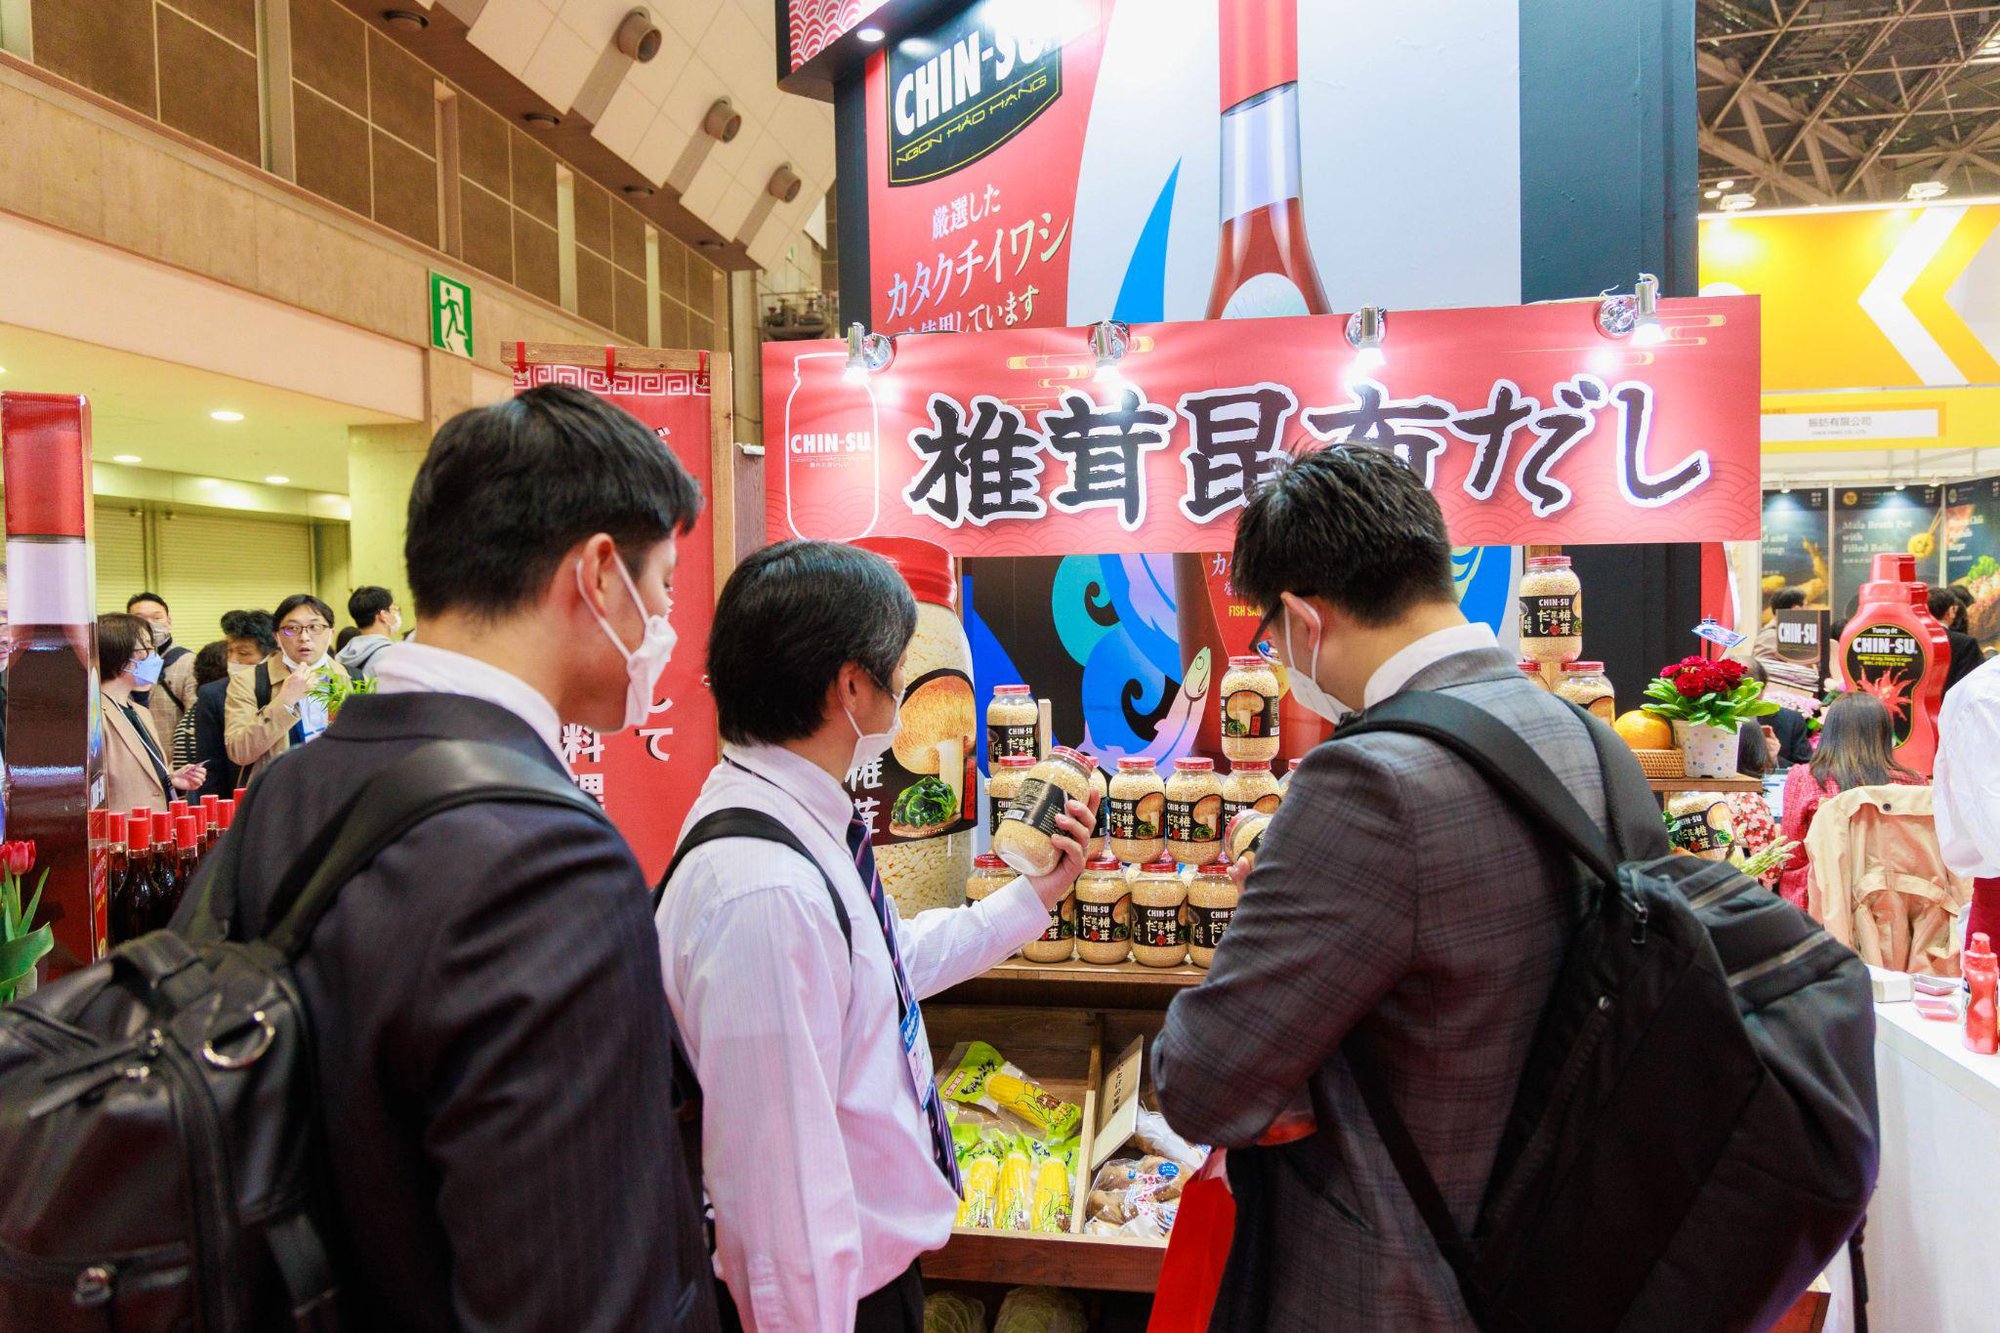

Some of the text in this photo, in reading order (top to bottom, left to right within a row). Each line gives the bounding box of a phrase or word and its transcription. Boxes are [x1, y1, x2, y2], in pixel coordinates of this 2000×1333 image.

[932, 184, 1001, 241] 厳選した
[886, 212, 1070, 324] カタクチイワシ
[790, 431, 872, 454] CHIN-SU
[1538, 598, 1570, 606] CHIN-SU
[1228, 605, 1246, 616] FISH
[1778, 622, 1818, 644] CHIN-SU
[1852, 637, 1915, 655] CHIN-SU
[1082, 904, 1110, 914] CHIN-SU
[1146, 909, 1175, 918] CHIN-SU
[1210, 910, 1236, 919] CHIN-S
